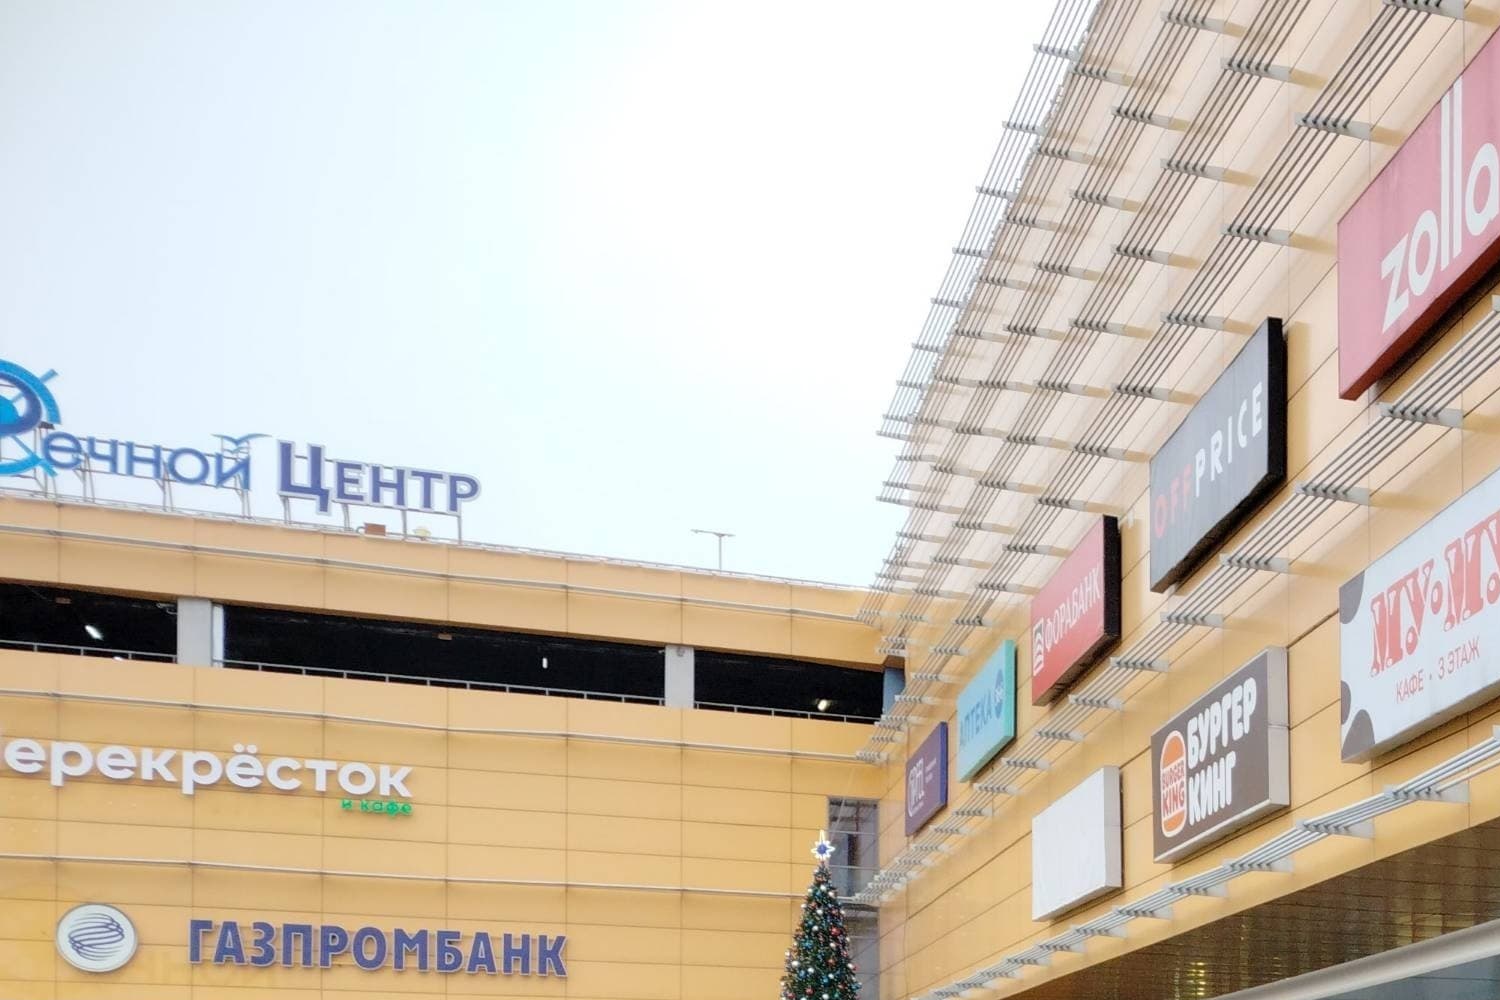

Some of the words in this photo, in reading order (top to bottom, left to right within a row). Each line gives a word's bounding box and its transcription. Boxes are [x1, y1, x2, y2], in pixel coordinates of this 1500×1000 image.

[1381, 75, 1500, 334] zolla
[1044, 566, 1101, 652] ФОРАБАНК
[1396, 668, 1424, 704] КАФЕ
[1444, 635, 1481, 675] ЭТАЖ
[959, 688, 993, 748] АПТЕКА
[1187, 677, 1257, 769] БУРГЕР
[3, 738, 412, 798] ерекрёсток
[1162, 759, 1185, 790] BURGER
[1188, 751, 1237, 826] КИНГ
[360, 799, 413, 818] кафе
[1162, 779, 1186, 818] KING
[189, 918, 568, 978] ГАЗПРОМБАНК
